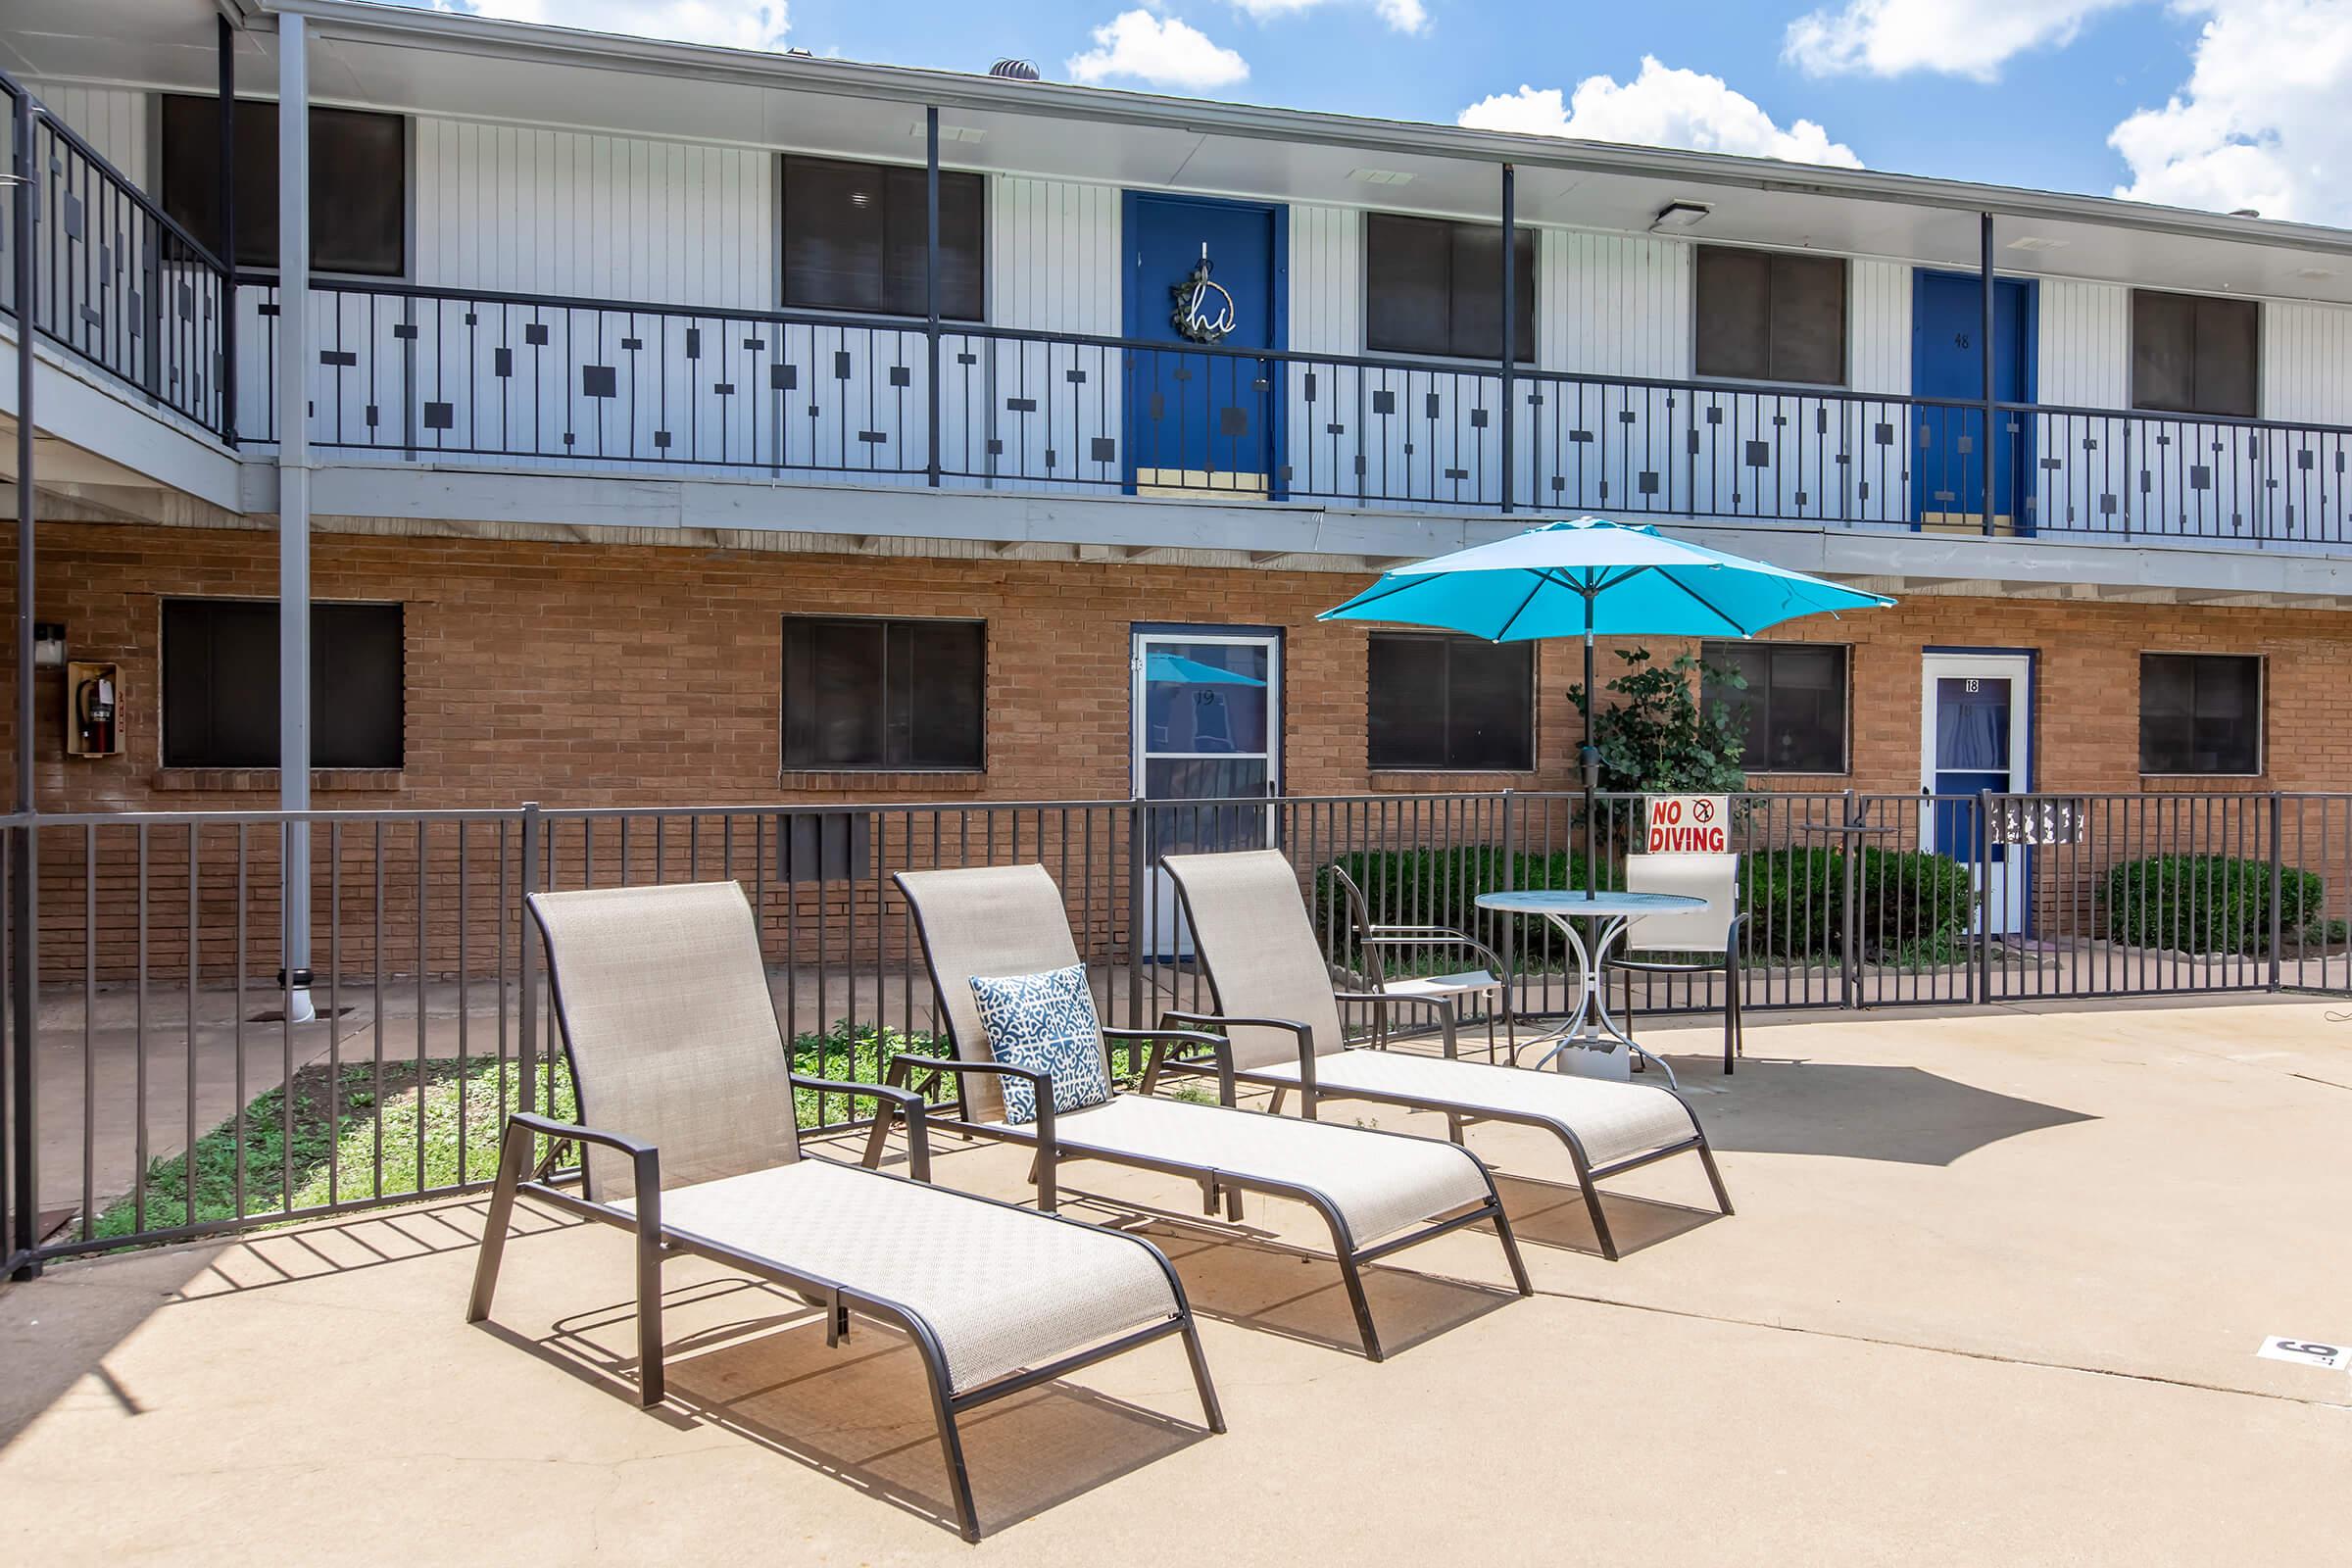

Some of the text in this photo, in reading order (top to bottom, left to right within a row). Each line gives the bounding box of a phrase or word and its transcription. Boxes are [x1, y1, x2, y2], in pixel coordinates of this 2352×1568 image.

[1186, 282, 1237, 332] hi
[1194, 689, 1214, 706] 19
[1967, 680, 1978, 692] 18
[1652, 800, 1682, 825] NO
[1649, 827, 1724, 853] DIVING
